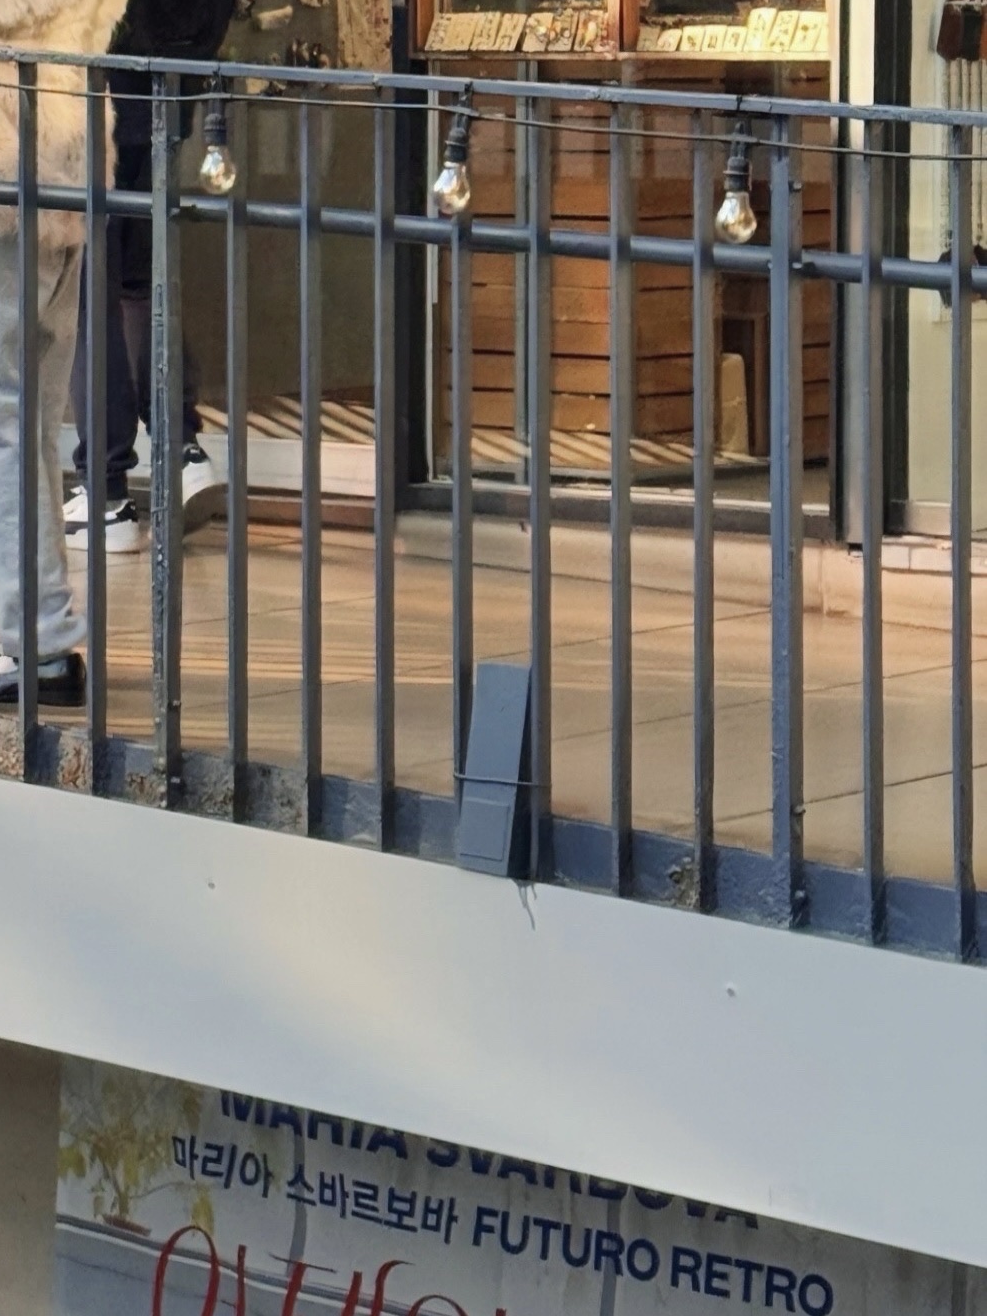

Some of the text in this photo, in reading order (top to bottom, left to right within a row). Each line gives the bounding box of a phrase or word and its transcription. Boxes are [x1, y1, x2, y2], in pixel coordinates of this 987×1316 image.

[172, 1135, 274, 1199] 마리아
[286, 1164, 459, 1245] 스바르보바
[472, 1206, 660, 1282] FUTURO
[670, 1246, 834, 1316] RETRO
